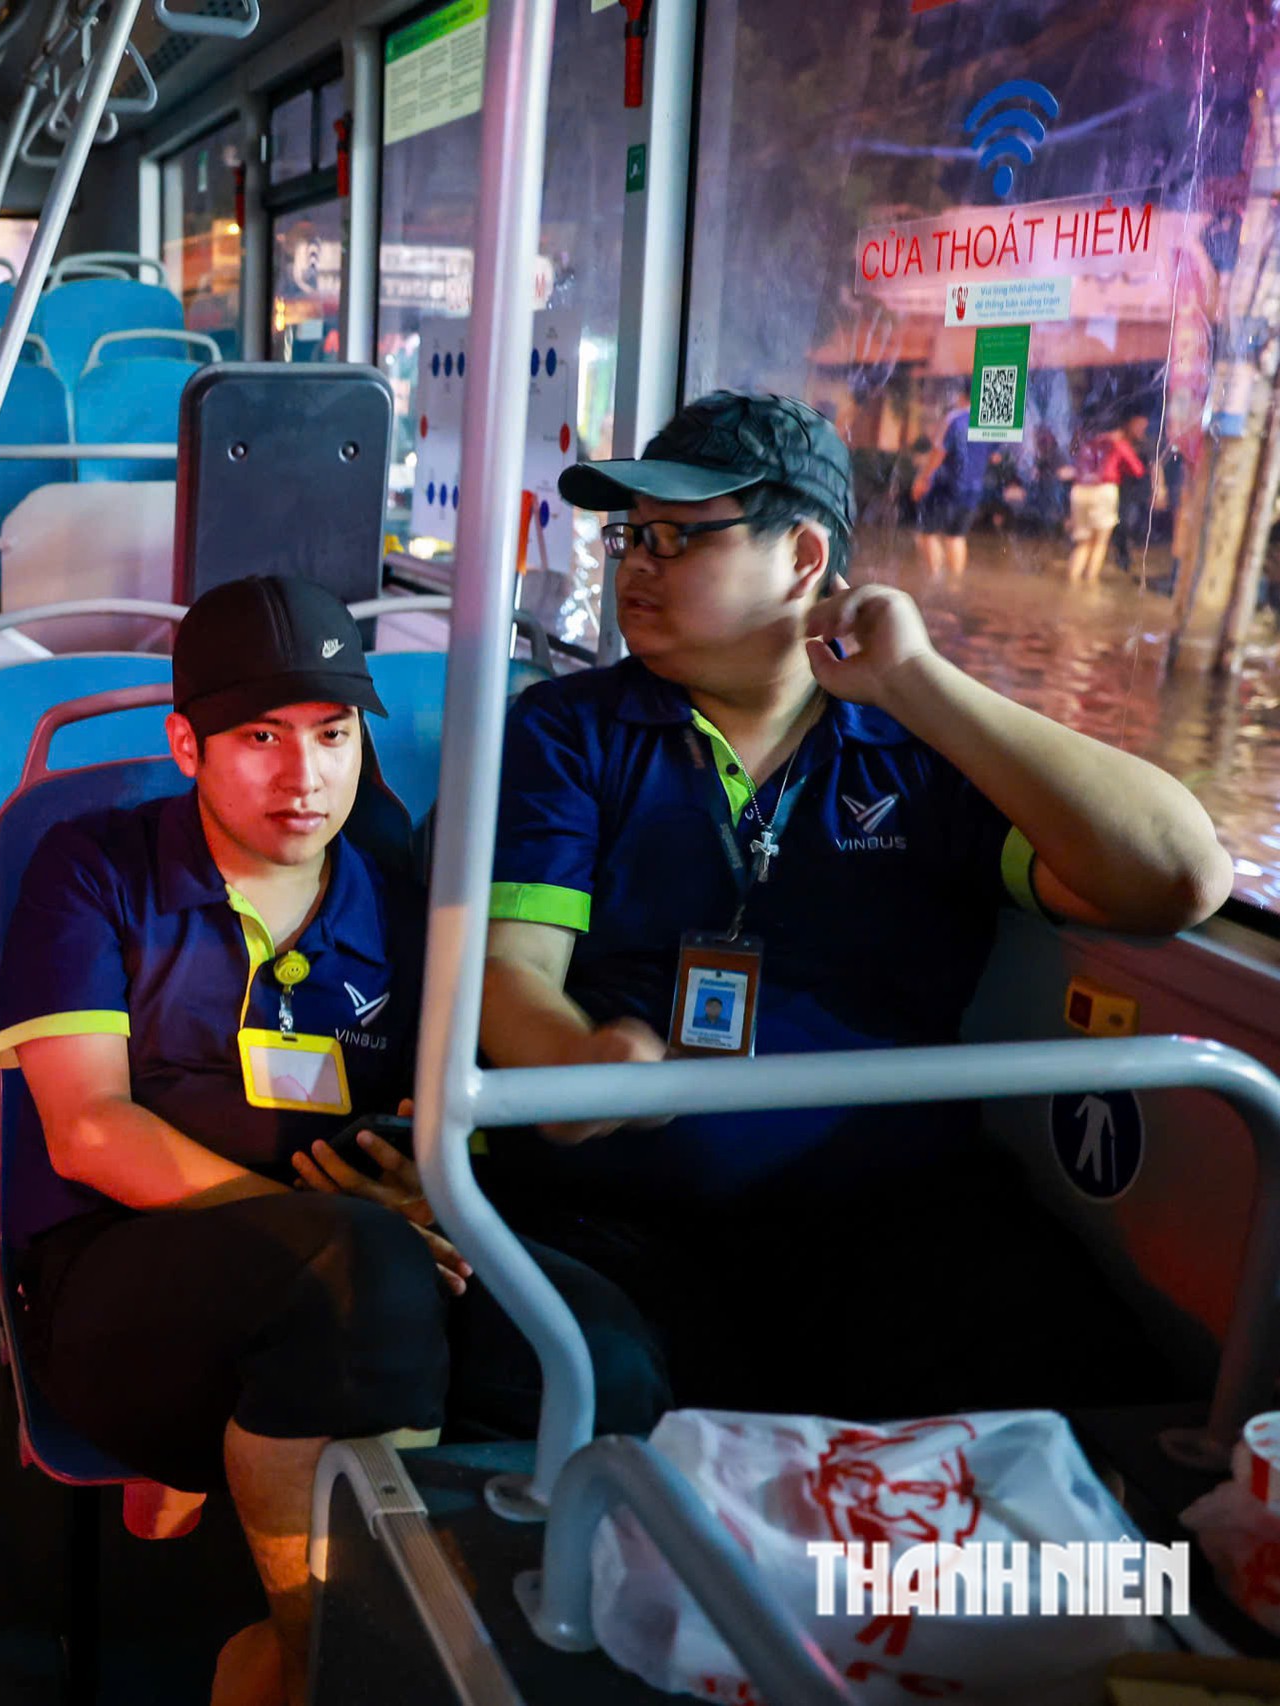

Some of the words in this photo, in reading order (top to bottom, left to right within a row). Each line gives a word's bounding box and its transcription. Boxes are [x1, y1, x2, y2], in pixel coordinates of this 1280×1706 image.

[861, 229, 923, 281] CỬA
[932, 211, 1045, 274] THOÁT
[1053, 196, 1153, 261] HIỂM
